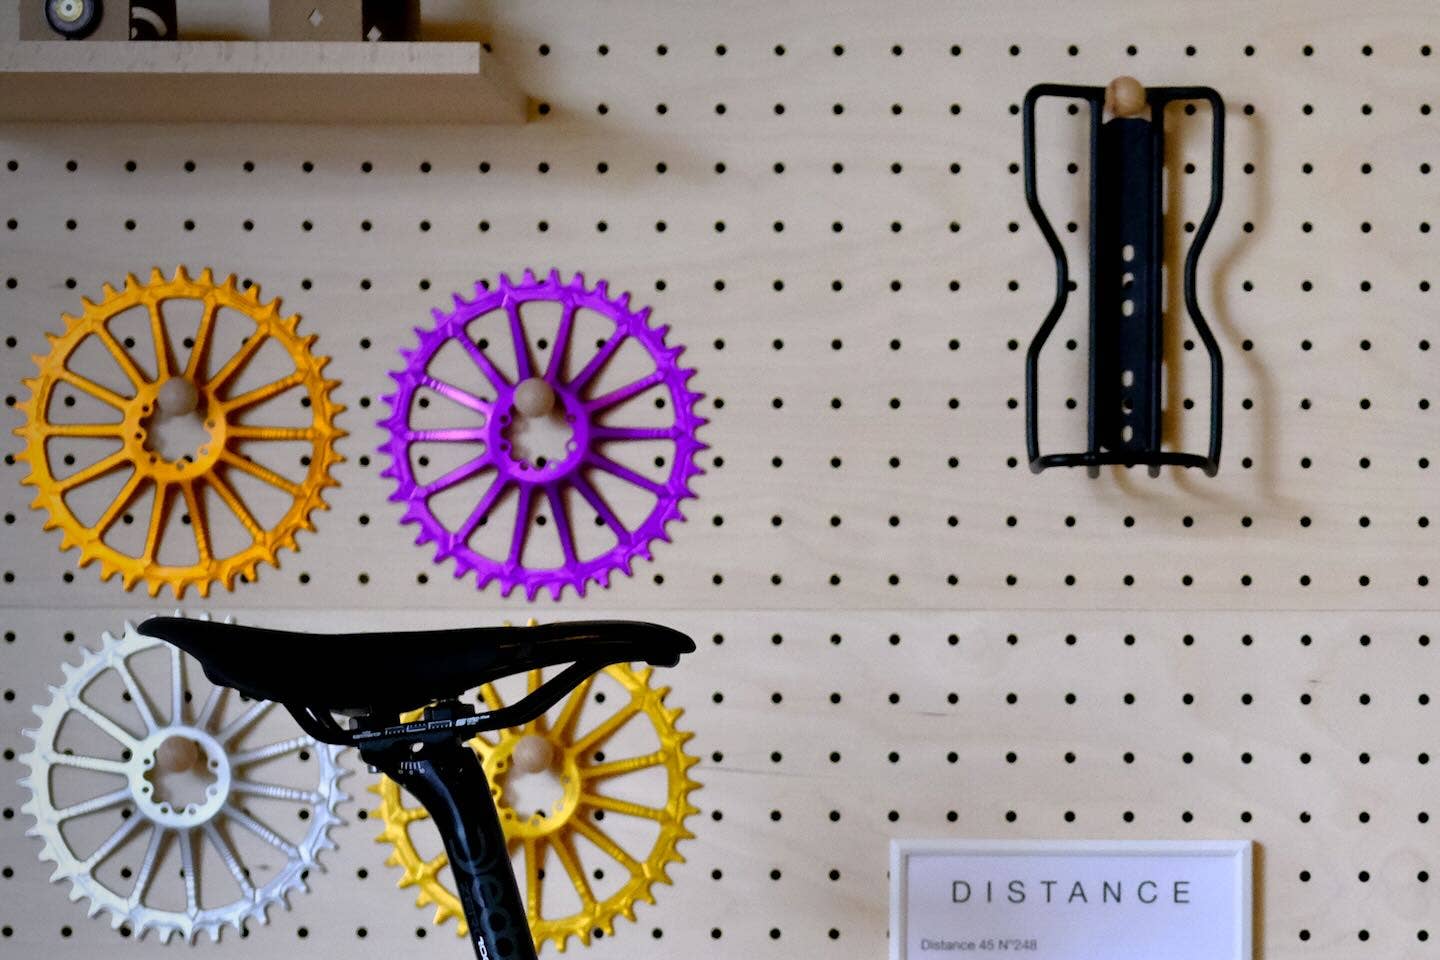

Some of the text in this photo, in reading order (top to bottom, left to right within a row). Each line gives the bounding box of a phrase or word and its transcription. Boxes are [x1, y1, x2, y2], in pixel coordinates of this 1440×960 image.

[951, 879, 1191, 905] DISTANCE
[920, 938, 976, 952] Distance
[978, 938, 996, 952] 45
